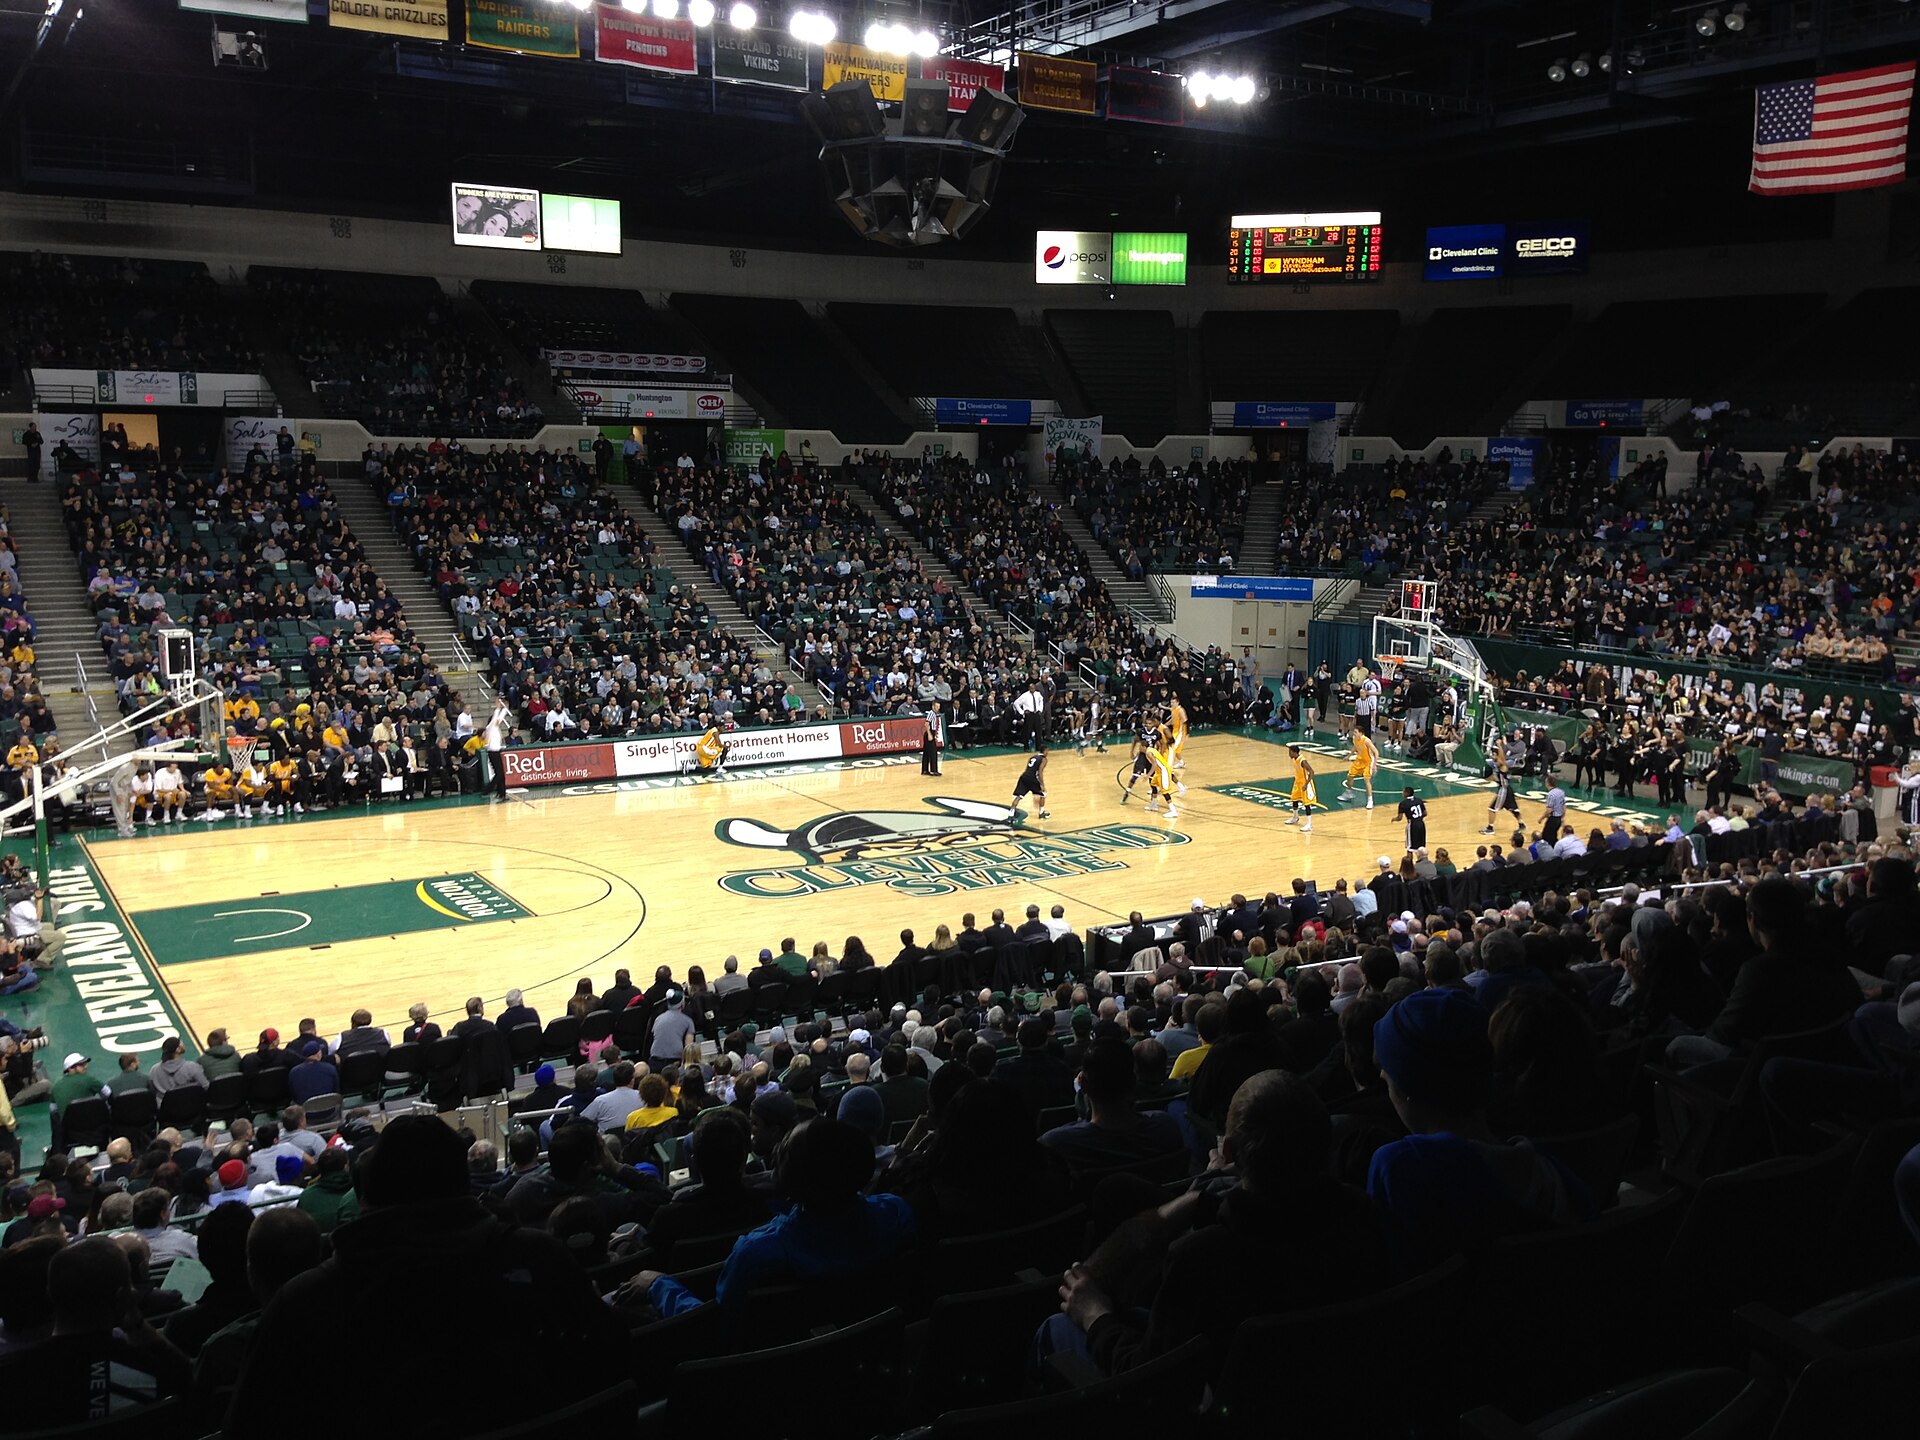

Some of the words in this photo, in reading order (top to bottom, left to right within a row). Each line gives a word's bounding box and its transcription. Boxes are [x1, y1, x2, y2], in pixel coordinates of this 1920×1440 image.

[331, 0, 379, 19] GOLDEN
[384, 8, 447, 27] GRIZZLIES
[474, 0, 528, 20] WRIGHT
[496, 20, 551, 39] RAIDERS
[602, 18, 661, 36] YOUNGSTOWN
[662, 26, 691, 42] STATE
[626, 39, 668, 57] PENGUINS
[718, 36, 772, 55] CLEVELAND
[776, 44, 804, 61] STATE
[743, 54, 780, 72] VIKINGS
[840, 69, 891, 88] PANTHERS
[935, 69, 991, 88] DETROIT
[948, 86, 978, 101] ITAN
[1033, 84, 1082, 102] CRUSADERS
[333, 228, 352, 239] 105
[1273, 233, 1285, 243] 20
[1294, 228, 1318, 238] 13:31
[1327, 232, 1339, 241] 28
[1516, 237, 1577, 251] GEICO
[730, 250, 746, 259] 207
[1069, 251, 1107, 264] pepsi
[1442, 248, 1477, 258] Cleveland
[1477, 247, 1498, 256] Clinic
[1518, 250, 1574, 258] #AlumniSavings
[547, 255, 567, 266] 206
[732, 259, 746, 269] 107
[1282, 257, 1325, 265] WYNDHAM
[549, 265, 567, 276] 106
[1452, 264, 1495, 273] clevelandclinic.org
[134, 373, 160, 386] Sal's
[636, 393, 673, 404] Huntington
[698, 397, 722, 408] OH!
[967, 403, 993, 411] Cleveland
[993, 403, 1008, 411] Clinic
[1267, 405, 1294, 413] Cleveland
[1573, 410, 1589, 420] Go
[67, 416, 97, 438] Sal's
[233, 420, 269, 441] Sal's
[1067, 419, 1075, 430] &
[725, 442, 774, 457] GREEN
[1232, 582, 1249, 590] Clinic
[627, 740, 697, 758] Single-Sto
[723, 733, 789, 753] partment
[792, 730, 830, 745] Homes
[866, 740, 899, 751] distinctive
[503, 747, 601, 775] Redwood
[1027, 757, 1037, 768] 3
[520, 770, 562, 782] distinctive
[1777, 767, 1840, 789] vikings.com
[1411, 805, 1423, 819] 31
[718, 824, 1193, 898] CLEVELAND
[886, 855, 1131, 897] STATE
[36, 865, 106, 915] STATE
[459, 876, 518, 914] LEAGUE
[430, 880, 498, 918] HORIZON
[57, 920, 180, 1053] CLEVELAND
